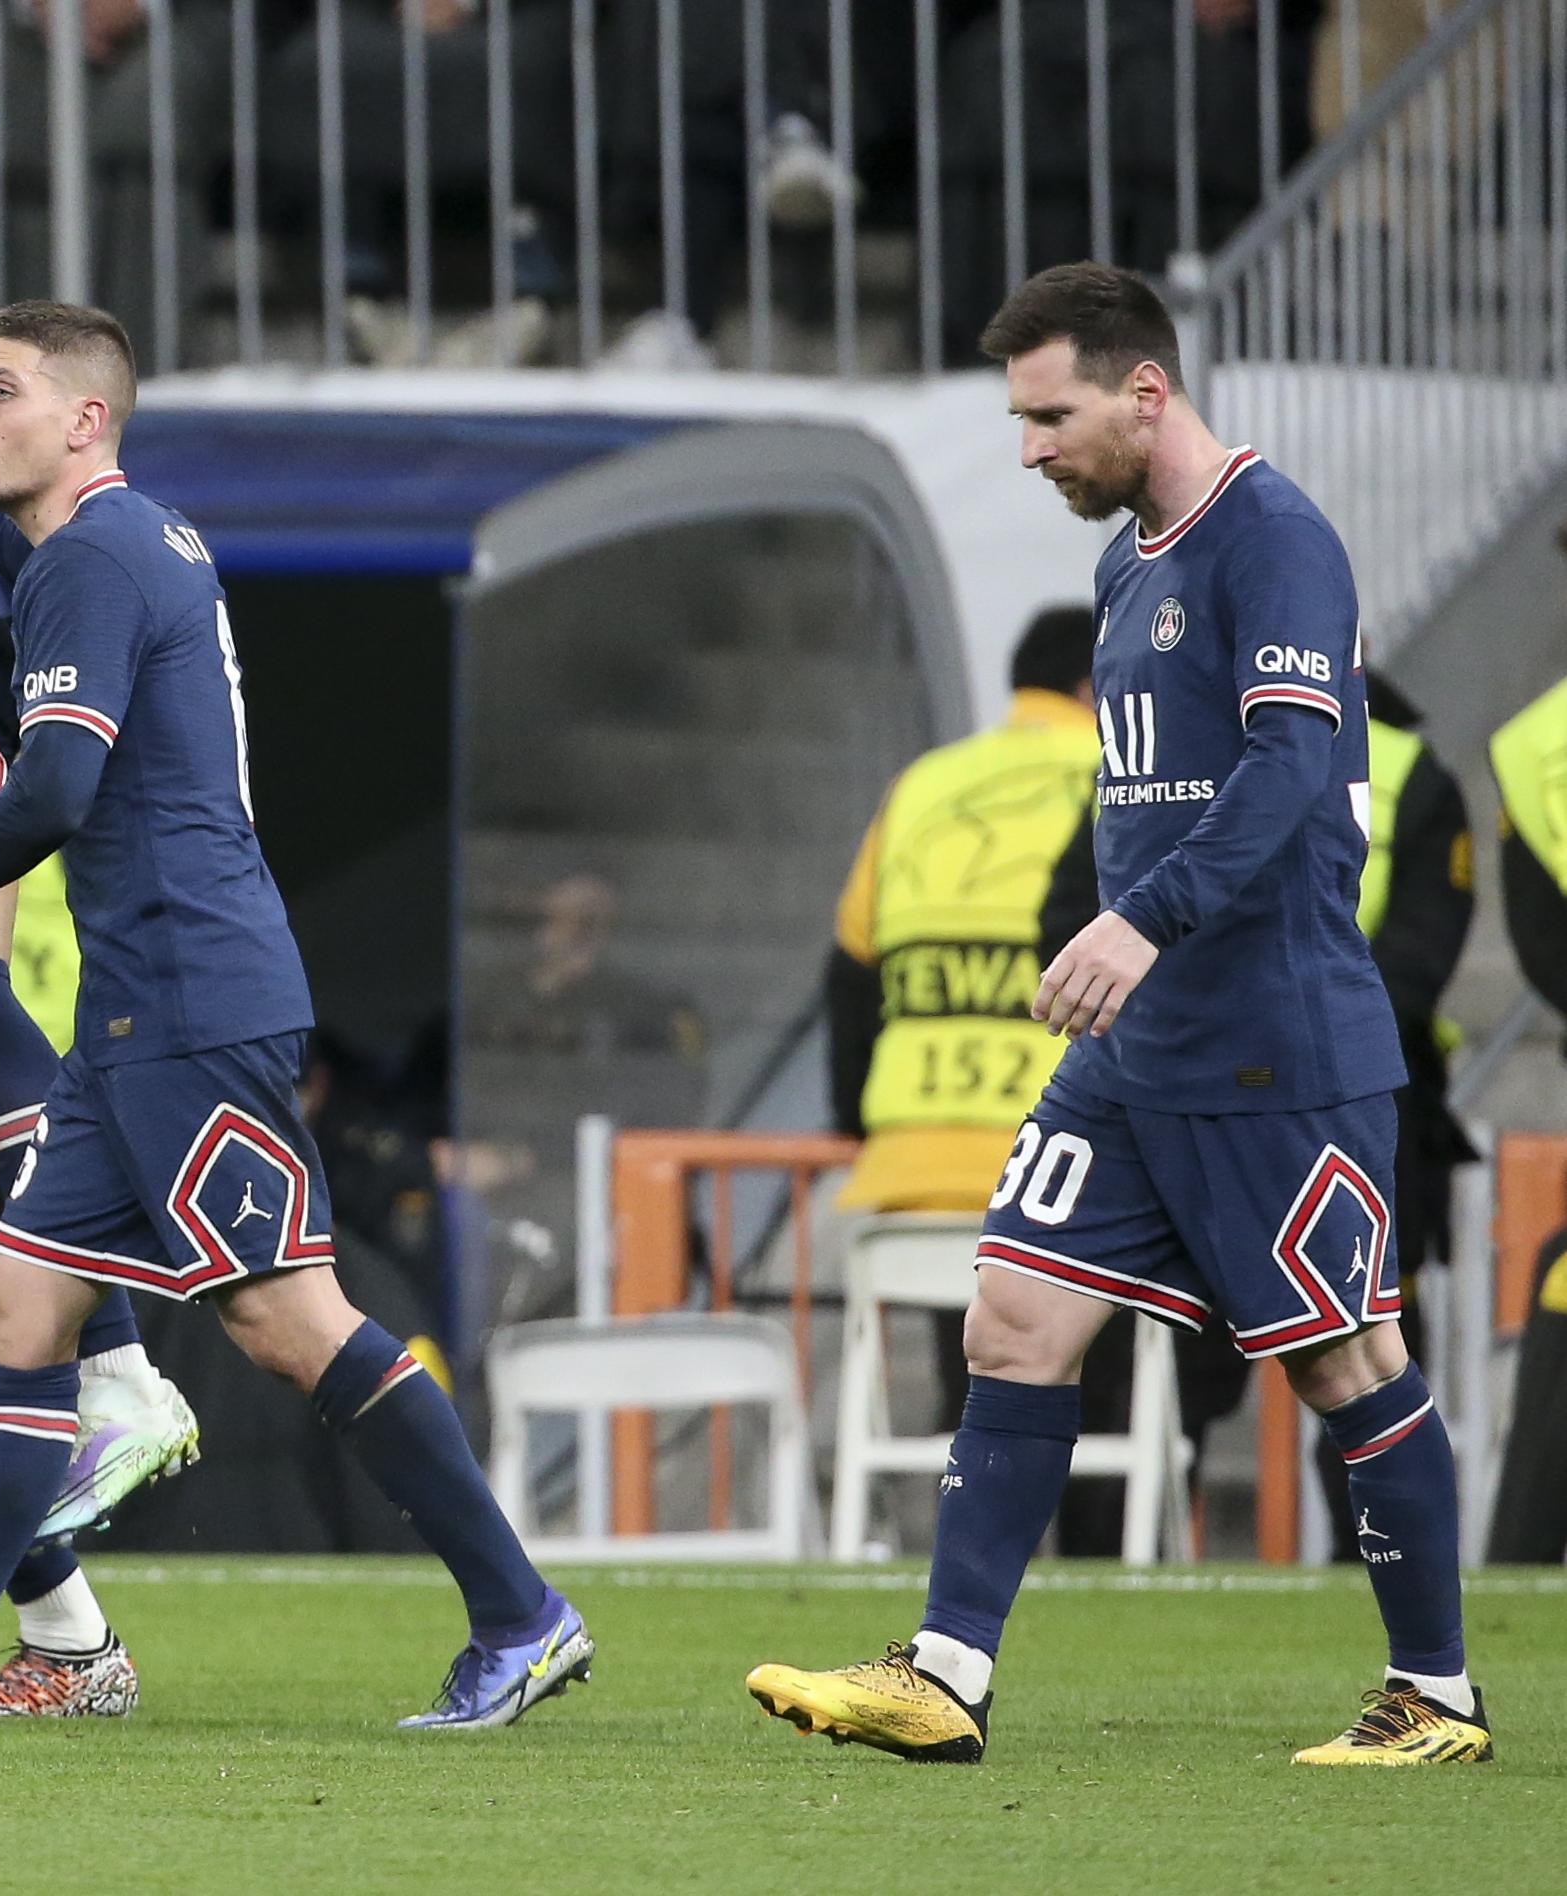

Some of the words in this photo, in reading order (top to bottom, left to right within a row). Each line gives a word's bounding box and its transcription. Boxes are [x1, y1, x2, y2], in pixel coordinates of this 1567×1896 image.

[1255, 644, 1332, 682] QNB
[23, 665, 78, 702] QNB
[1101, 785, 1128, 806] LIVE
[1128, 779, 1215, 805] LIMITLESS
[918, 1038, 1034, 1098] 152
[987, 1121, 1095, 1226] 30
